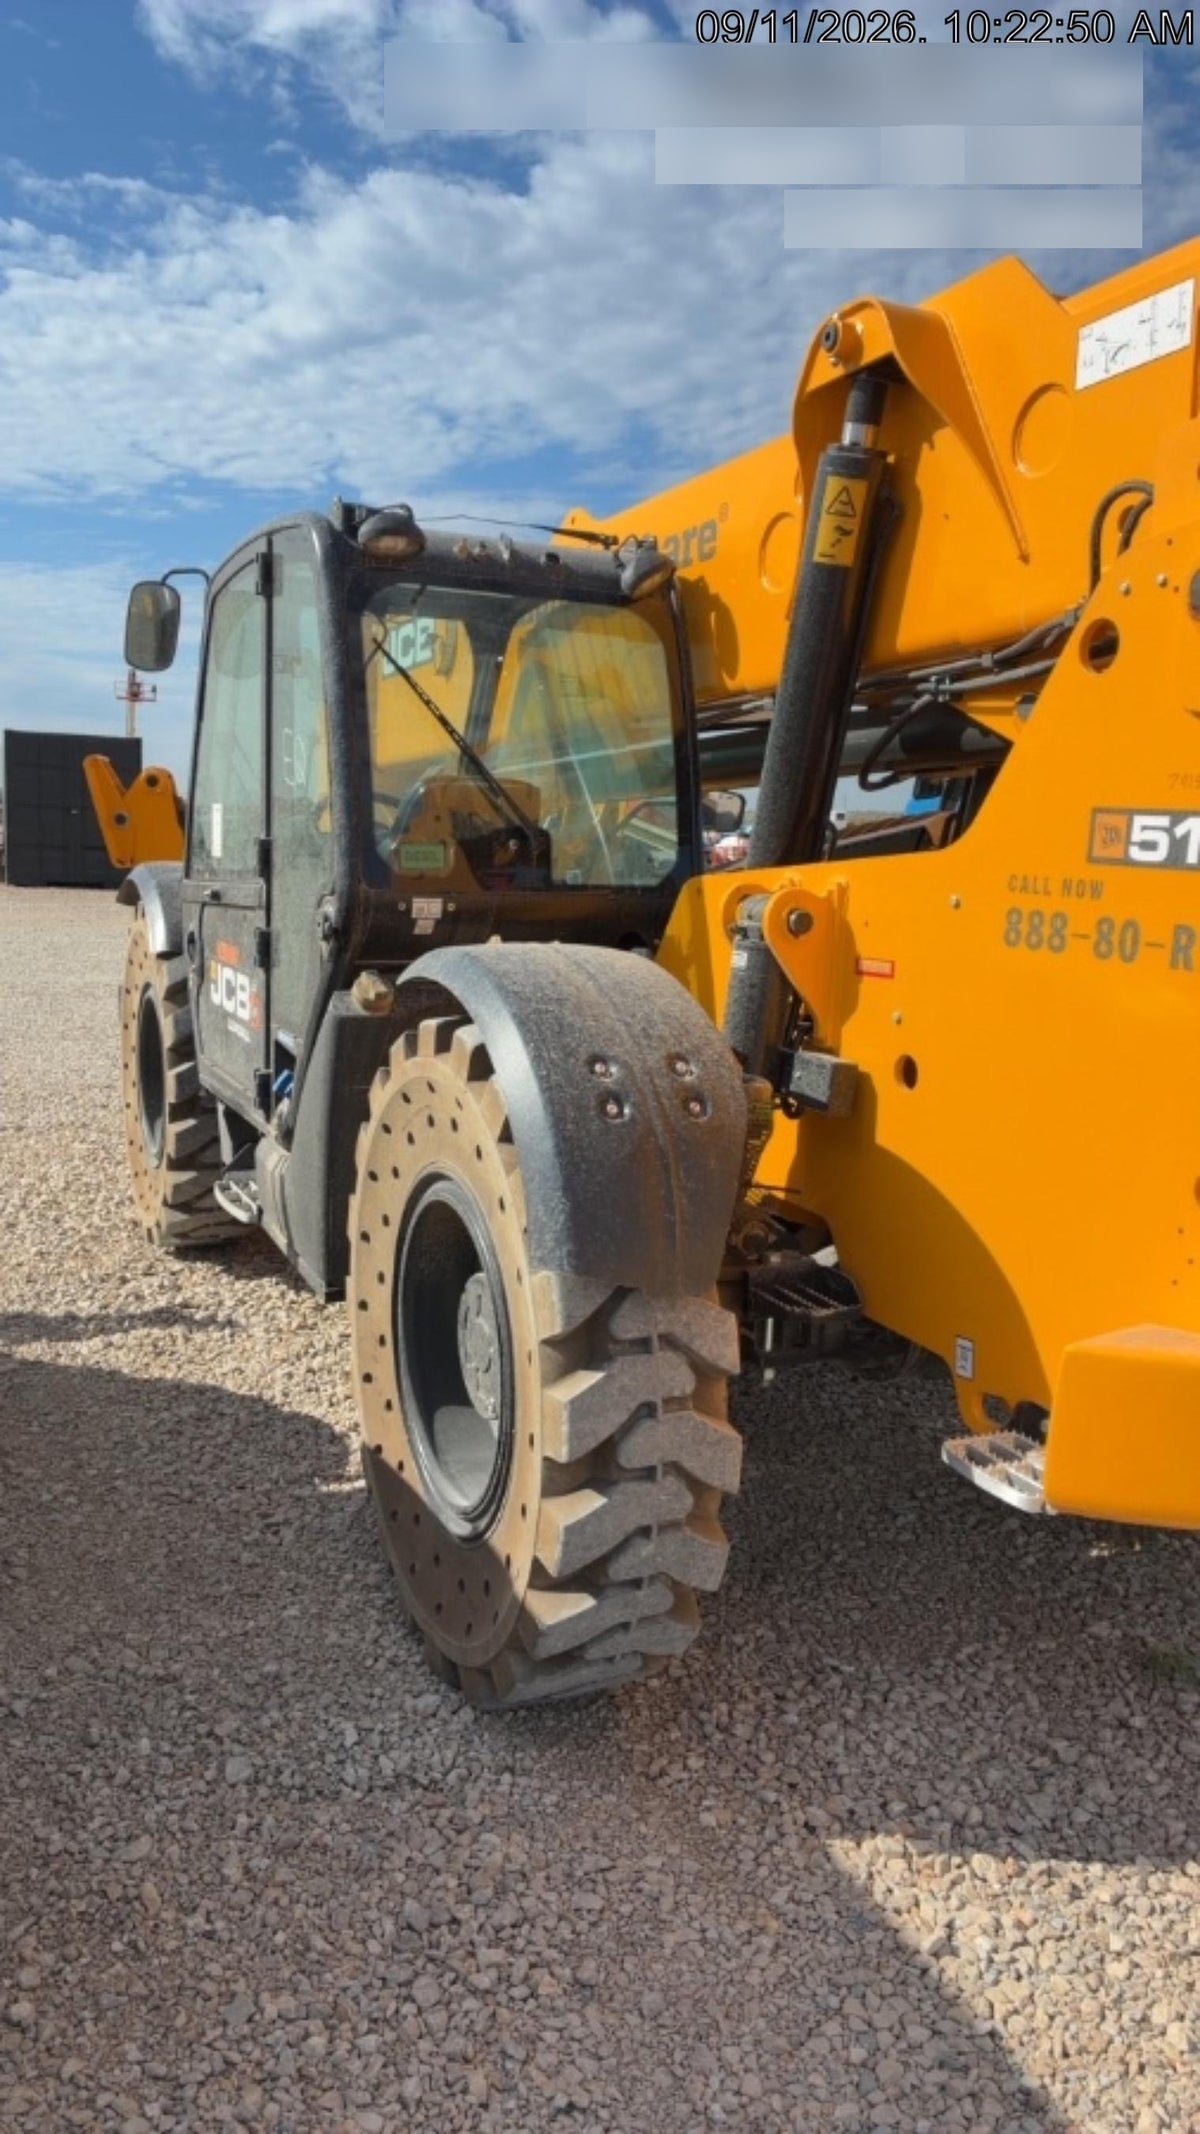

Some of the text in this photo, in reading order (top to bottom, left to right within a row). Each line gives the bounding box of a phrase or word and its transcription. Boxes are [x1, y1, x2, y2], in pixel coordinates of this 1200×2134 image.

[1128, 814, 1200, 864] 51
[1007, 874, 1104, 899] CALL NOW
[210, 960, 250, 1021] JCB
